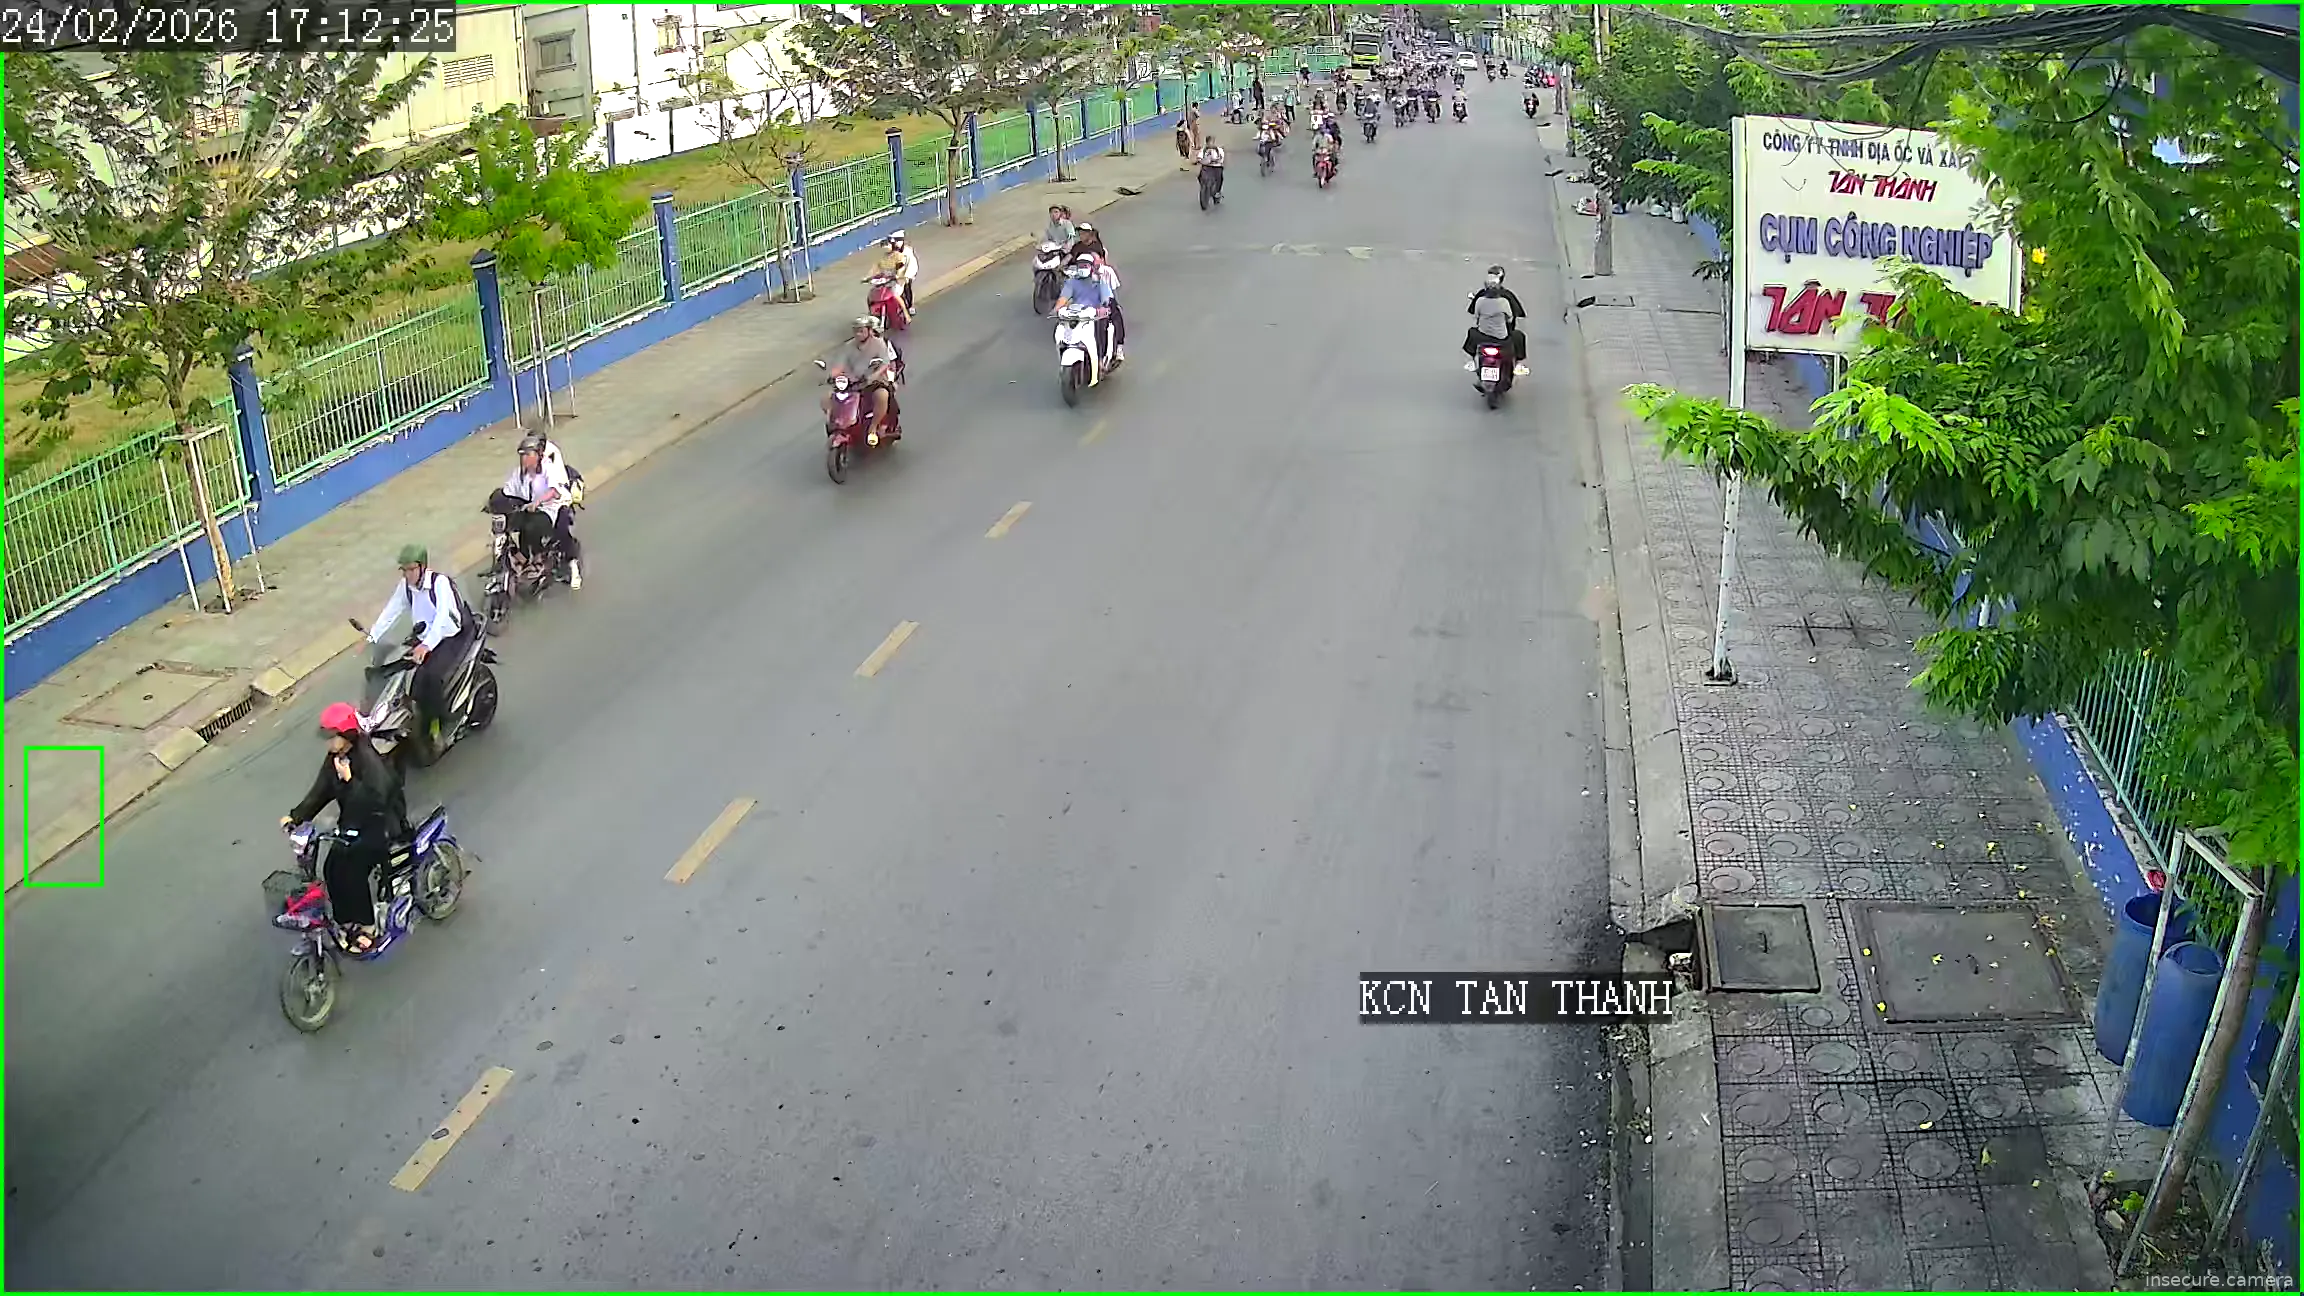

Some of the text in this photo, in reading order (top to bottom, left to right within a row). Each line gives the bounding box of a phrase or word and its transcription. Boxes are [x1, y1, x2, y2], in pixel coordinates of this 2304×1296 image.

[1762, 129, 1801, 153] CÔNG
[1828, 169, 1938, 202] TÂN THÀNH
[1760, 211, 1993, 278] CỤM CÔNG NGHIỆP
[1763, 278, 1847, 335] TÂN
